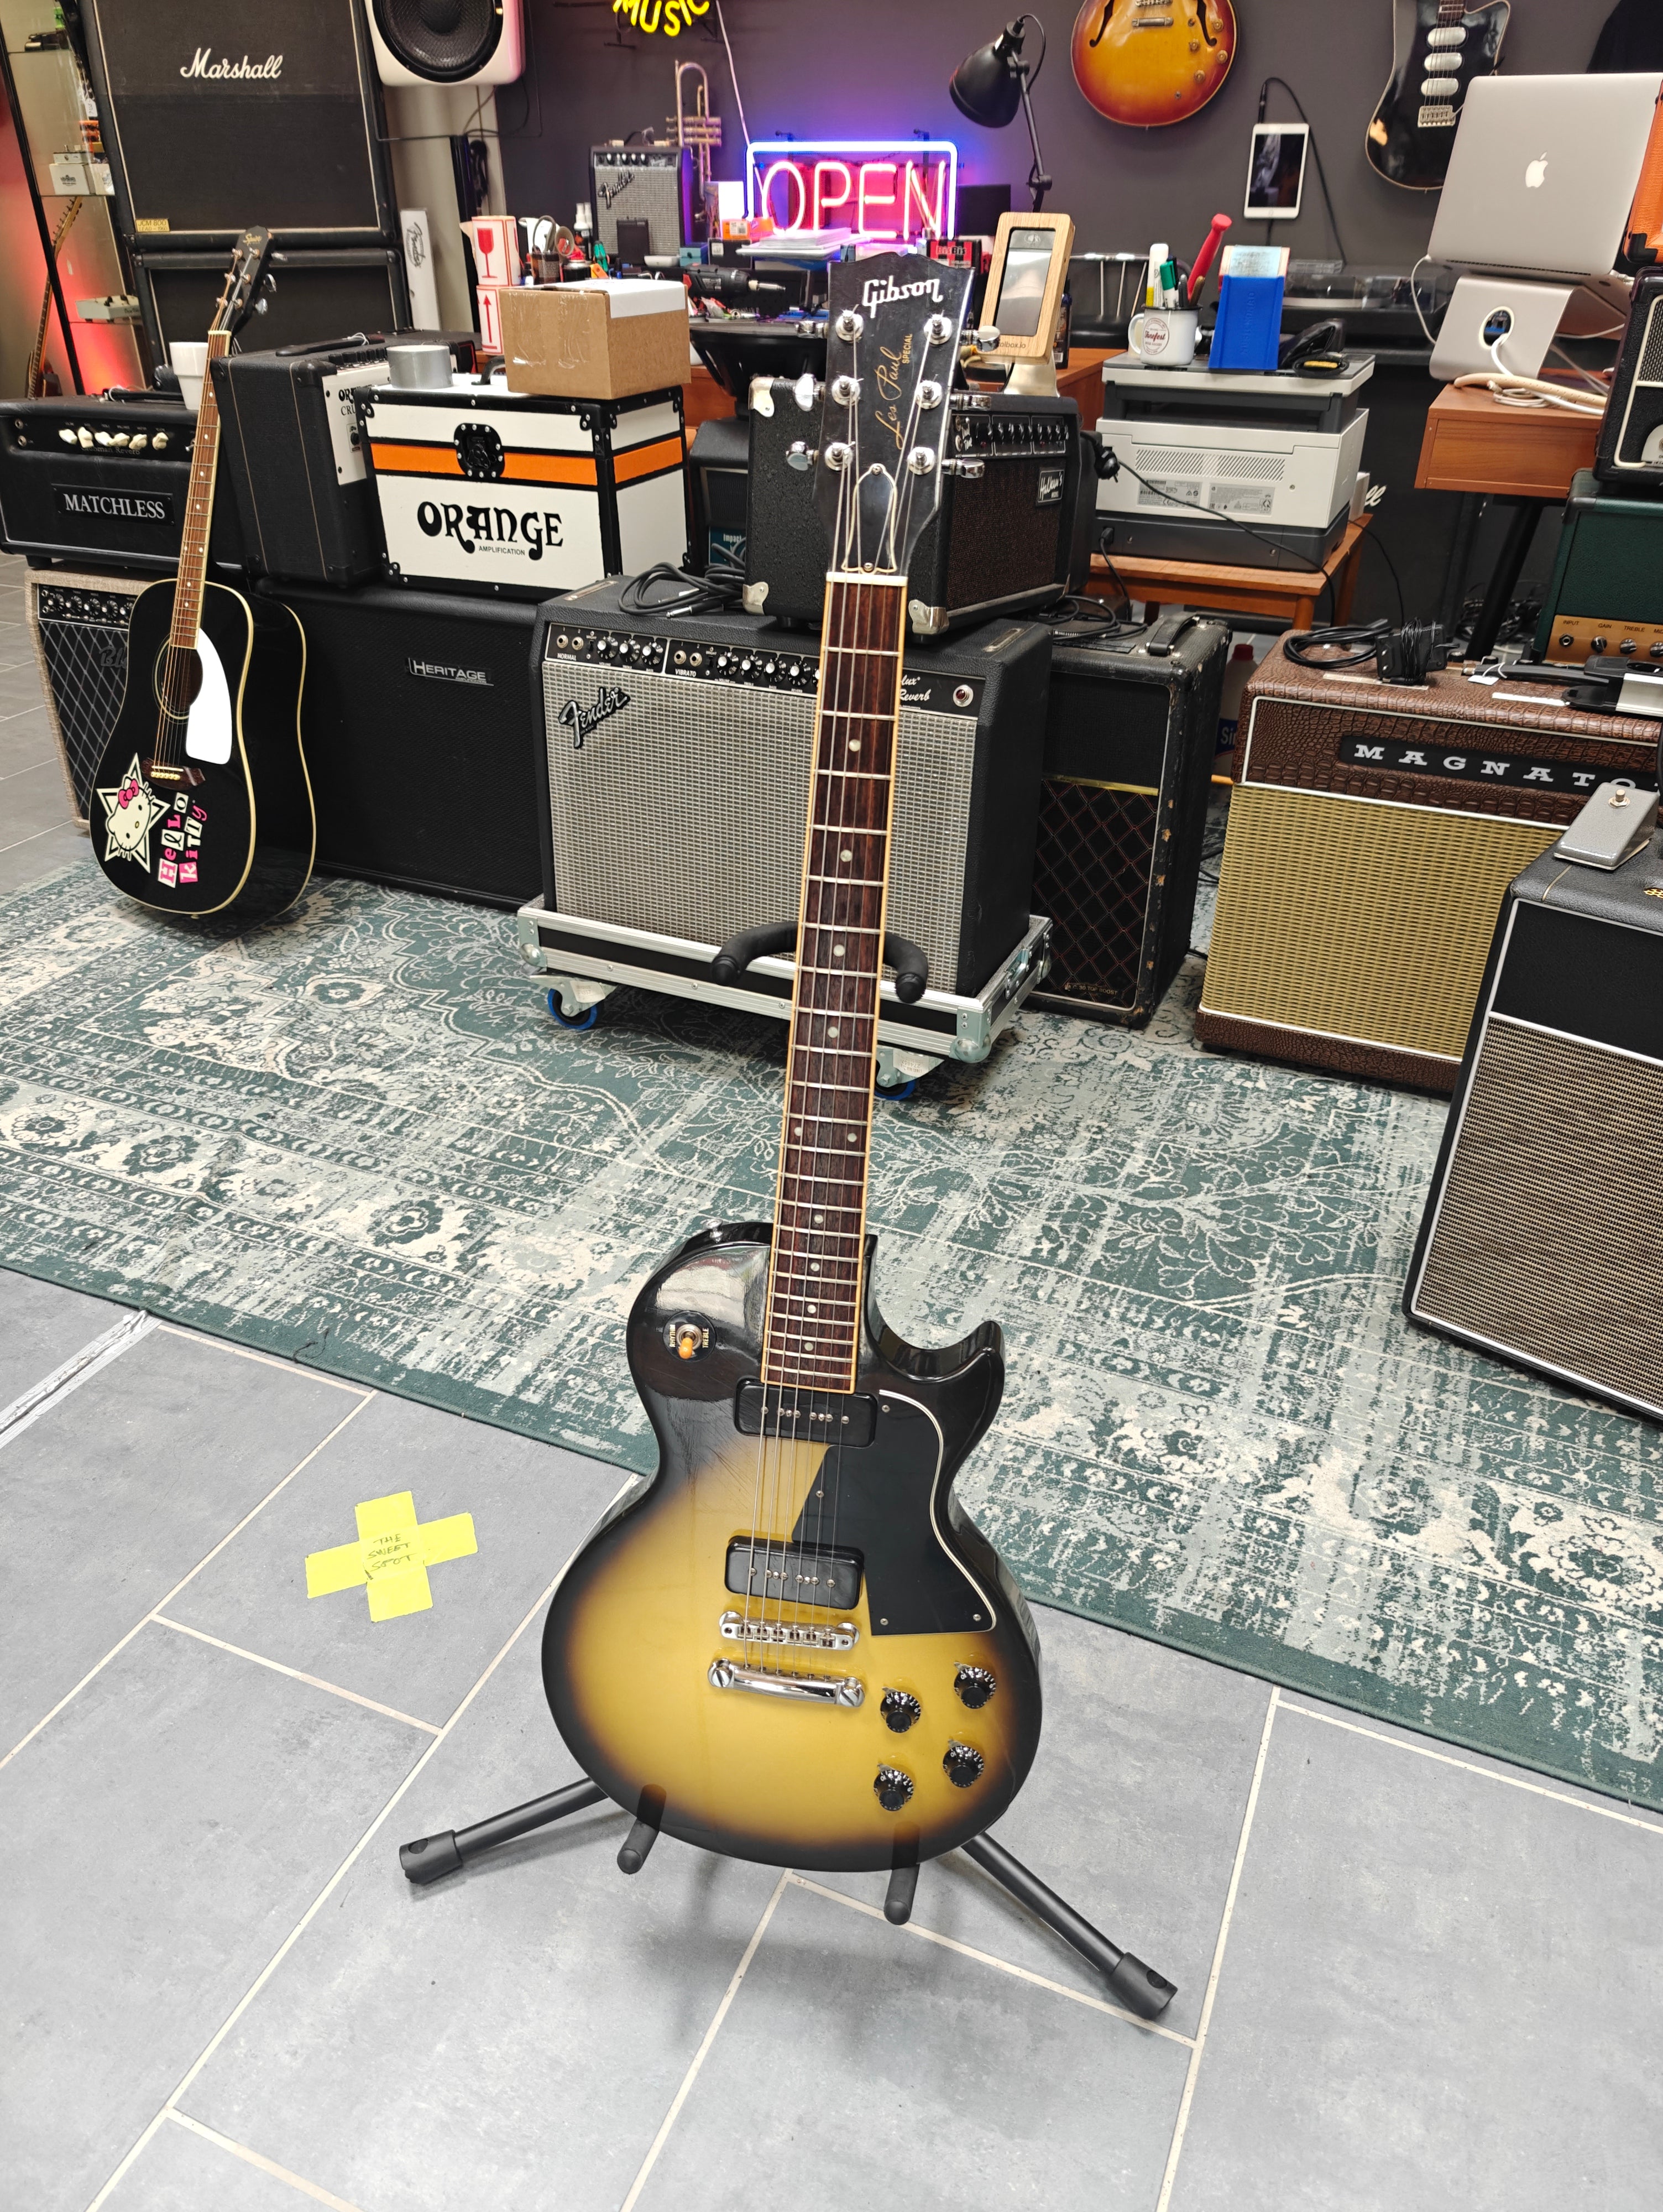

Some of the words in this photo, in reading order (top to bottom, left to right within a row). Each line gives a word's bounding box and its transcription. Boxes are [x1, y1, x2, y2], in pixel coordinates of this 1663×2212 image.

[180, 47, 283, 79] Marshall
[762, 160, 946, 241] OPEN
[862, 275, 943, 319] Gibson
[902, 333, 913, 364] SPECIAL
[874, 346, 902, 400] Paul
[341, 405, 357, 416] CRU
[875, 404, 904, 450] Les
[62, 493, 165, 519] MATCHLESS
[417, 501, 563, 561] ORANGE
[479, 545, 525, 556] AMPLIFICATION
[557, 653, 576, 661] NORMAL
[413, 660, 487, 681] HERITAGE
[675, 668, 697, 678] VIBRATO
[899, 688, 932, 701] Reverb
[558, 687, 628, 748] Fender
[367, 1542, 411, 1559] SWEET
[373, 1533, 401, 1546] THE
